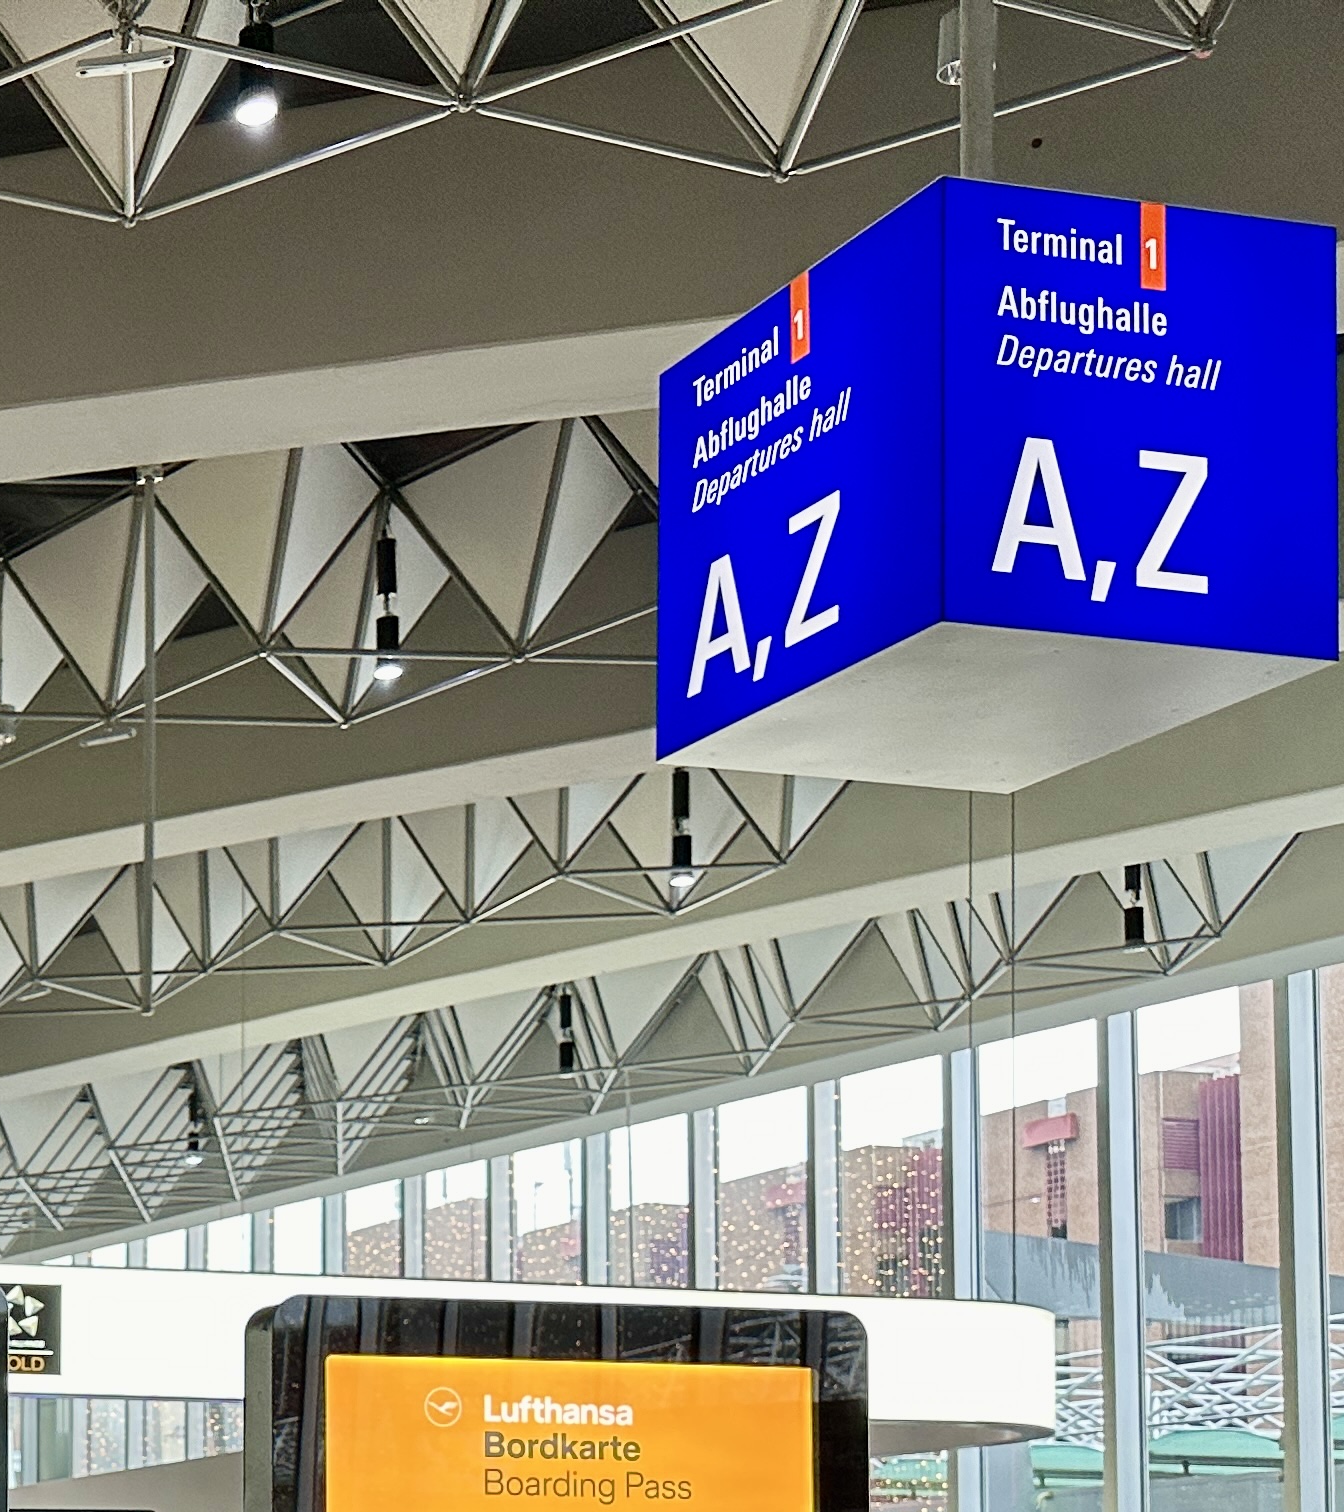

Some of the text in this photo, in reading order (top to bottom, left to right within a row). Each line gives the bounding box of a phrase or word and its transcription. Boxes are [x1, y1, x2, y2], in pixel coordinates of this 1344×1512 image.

[996, 217, 1159, 270] Terminal 1
[996, 284, 1168, 340] Abflughalle
[692, 308, 805, 408] Terminal 1
[996, 333, 1223, 392] Departures hall
[692, 373, 812, 469] Abflughalle
[691, 385, 852, 514] Departures hall
[483, 1394, 634, 1426] Lufthansa
[484, 1431, 641, 1462] Bordkarte
[484, 1468, 693, 1506] Boarding Pass
